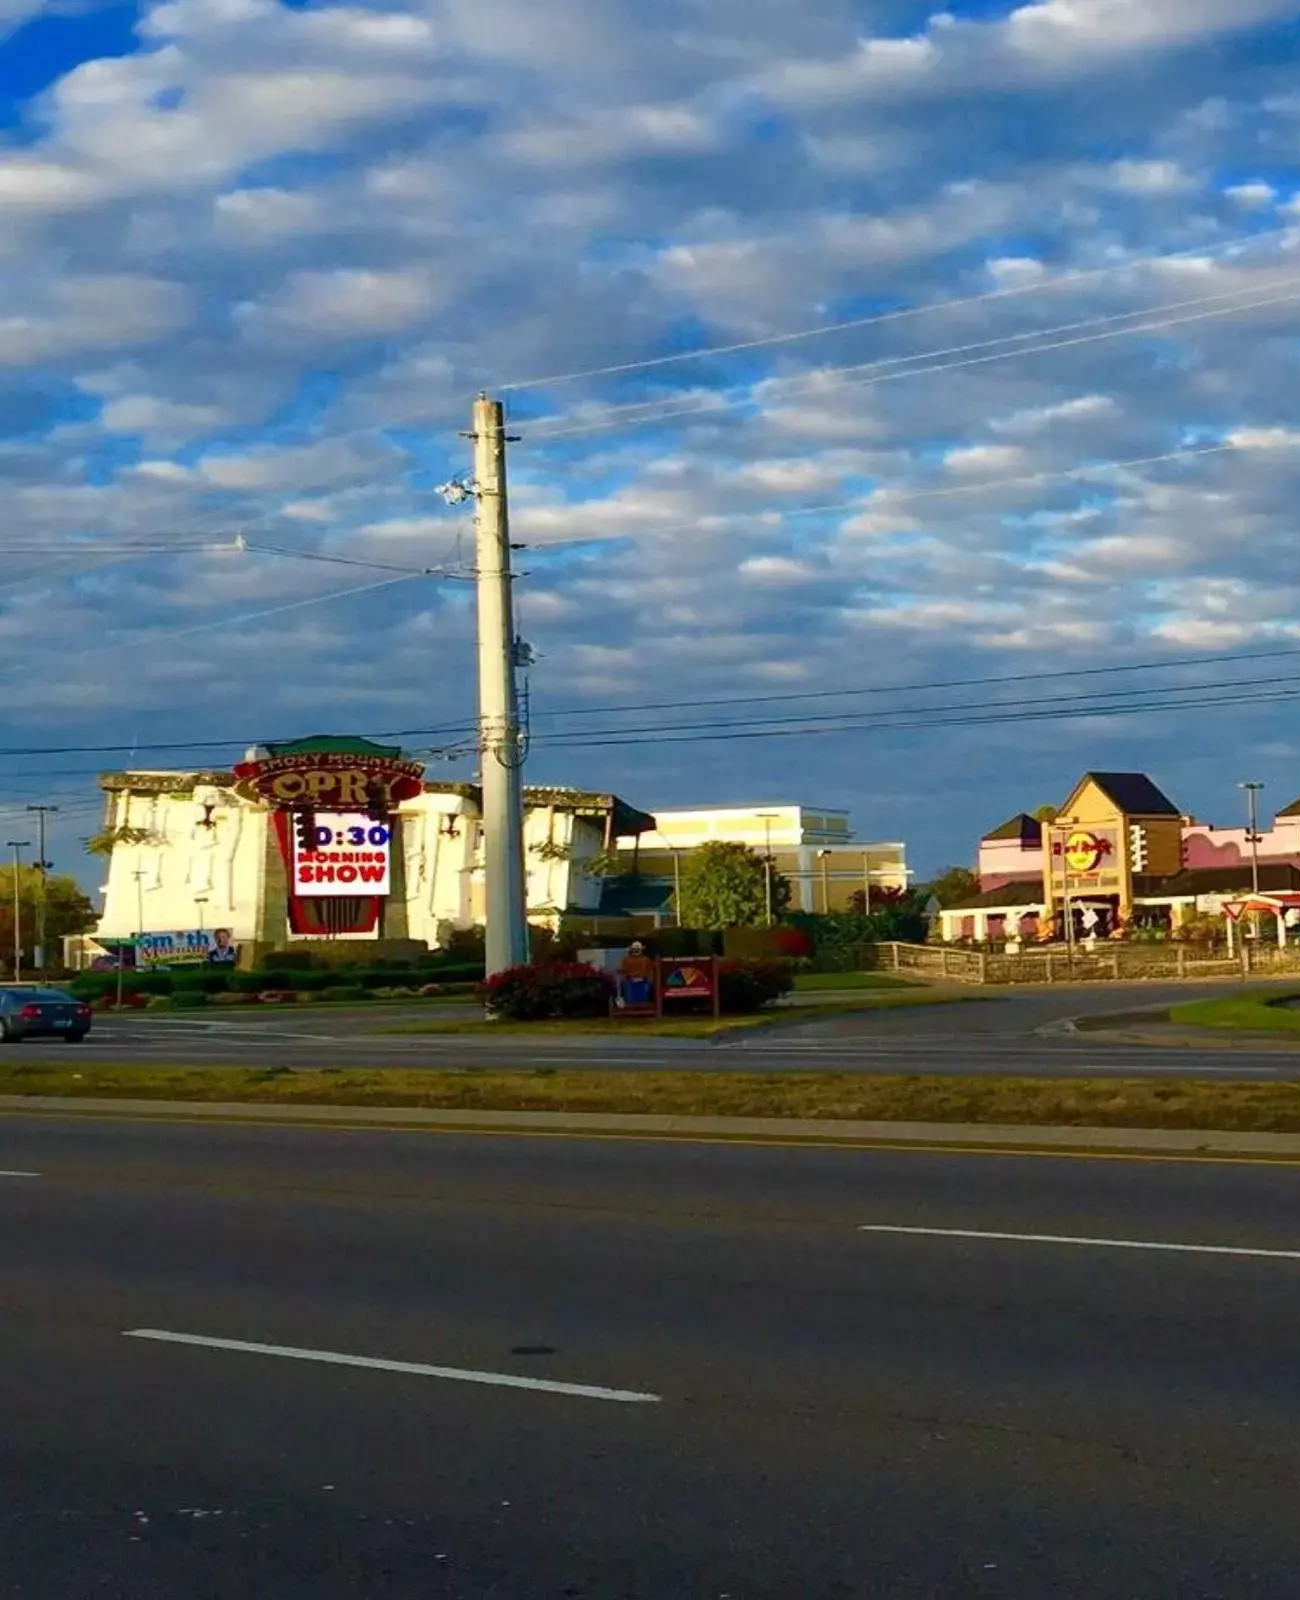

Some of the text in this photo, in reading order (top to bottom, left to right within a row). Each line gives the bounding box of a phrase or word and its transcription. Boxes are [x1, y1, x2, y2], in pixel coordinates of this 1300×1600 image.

[259, 753, 426, 776] SMOKY MOUNTAIN
[272, 769, 400, 804] OPRY
[297, 826, 391, 846] 0:30
[297, 852, 385, 864] MORNING
[298, 865, 386, 883] SHOW
